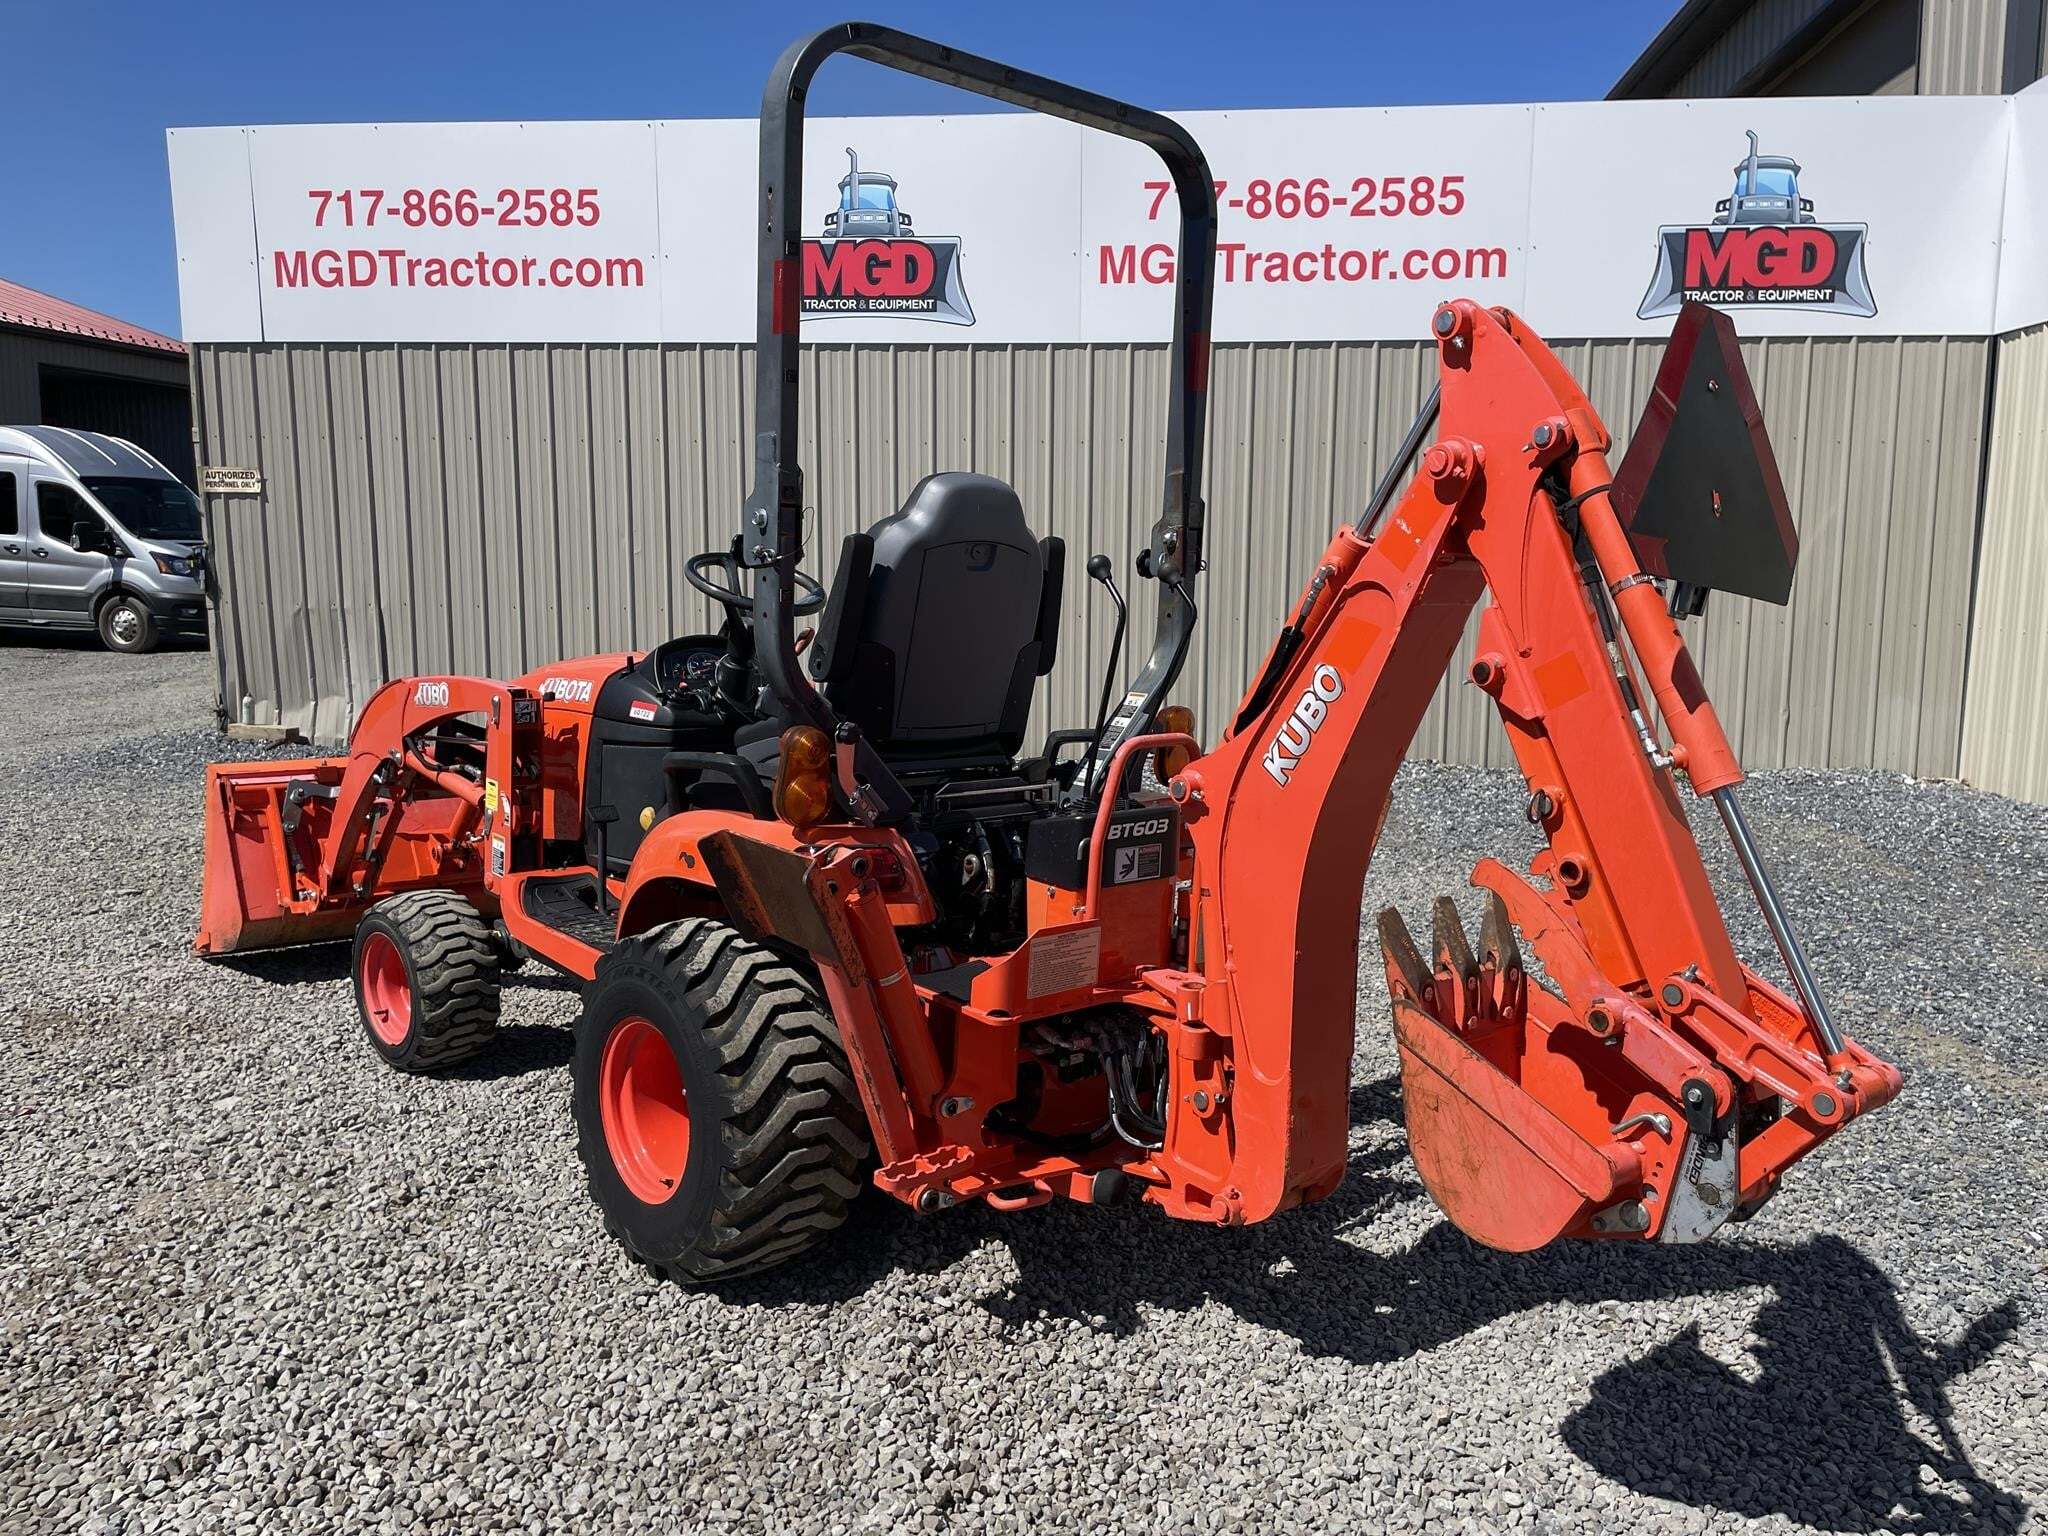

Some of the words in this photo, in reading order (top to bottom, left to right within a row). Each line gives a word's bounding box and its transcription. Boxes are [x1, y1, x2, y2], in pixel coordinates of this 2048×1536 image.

[308, 188, 600, 227] 717-866-2585
[1144, 175, 1465, 220] 77-866-2585
[274, 249, 644, 288] MGDTractor.com
[803, 240, 937, 297] MGD
[1099, 242, 1507, 285] MGTractor.com
[1684, 226, 1837, 288] MGD
[803, 299, 857, 310] TRACTOR
[858, 299, 867, 309] &
[868, 299, 935, 310] EQUIPMENT
[1684, 289, 1744, 302] TRACTOR
[1746, 290, 1755, 301] &
[1757, 288, 1833, 302] EQUIPMENT
[205, 470, 256, 480] AUTHORIZED
[205, 480, 239, 488] PERSONNEL
[240, 480, 256, 488] ONLY
[1107, 818, 1169, 840] BT603
